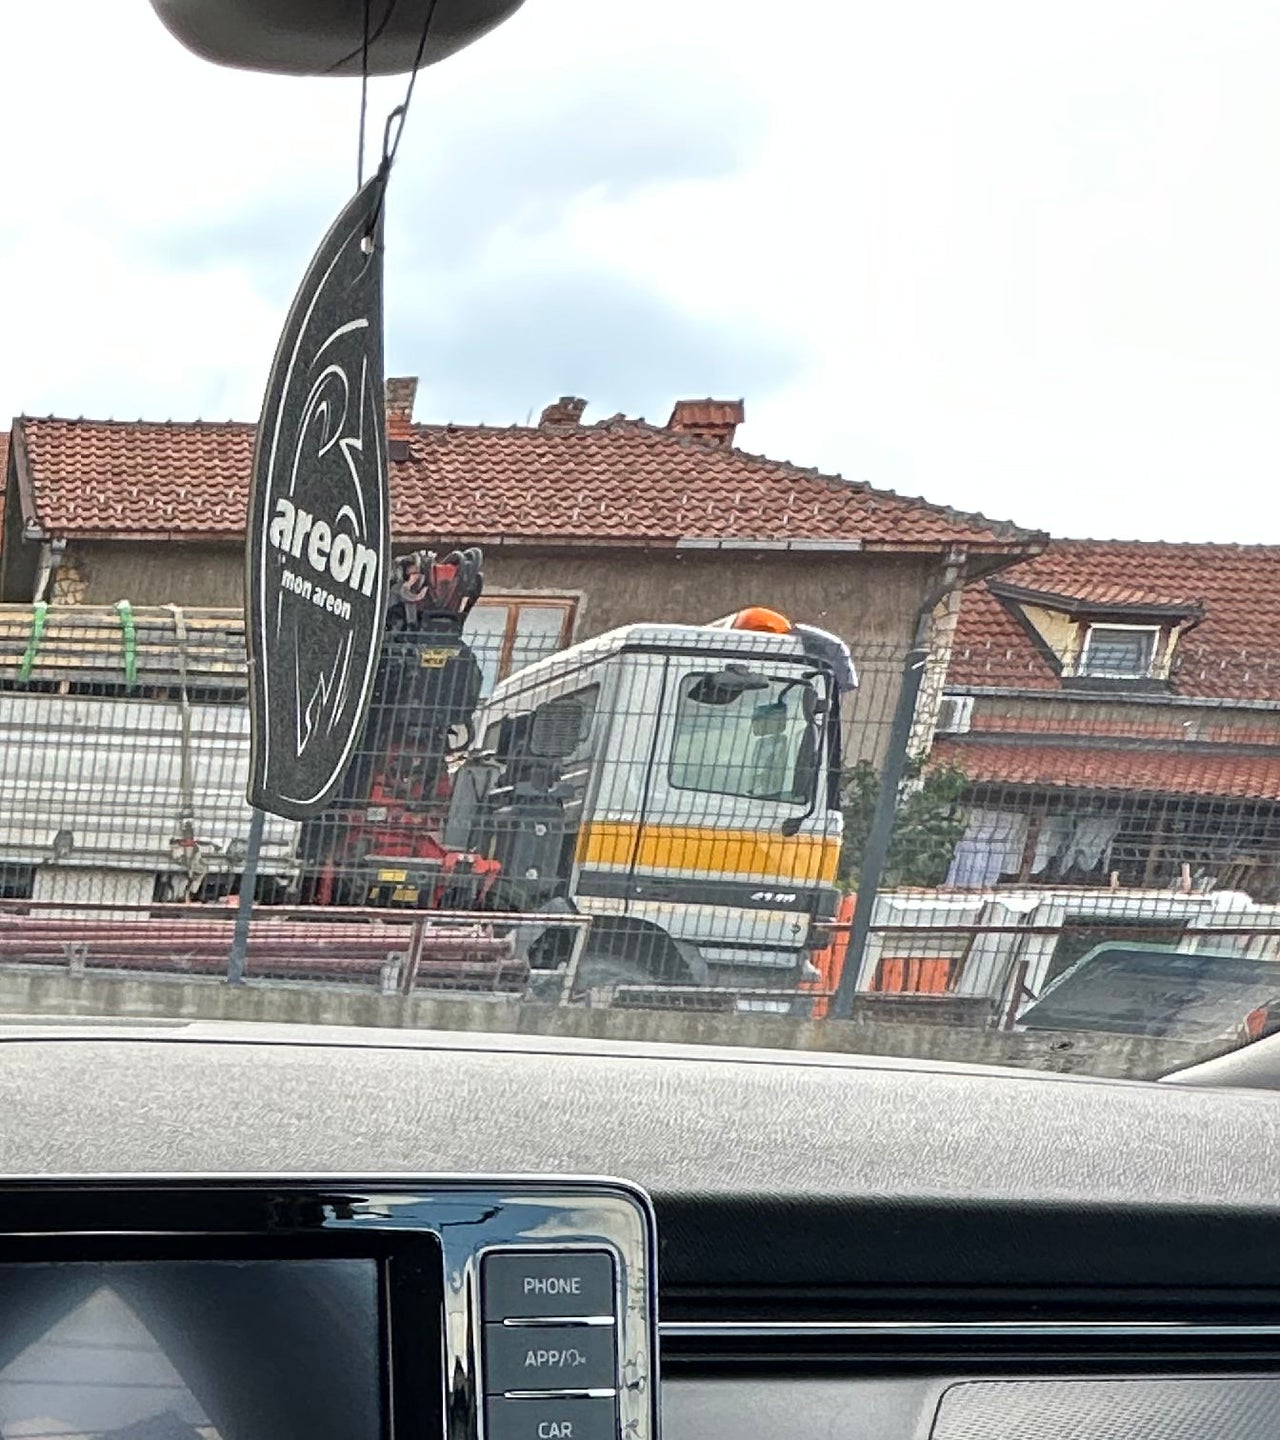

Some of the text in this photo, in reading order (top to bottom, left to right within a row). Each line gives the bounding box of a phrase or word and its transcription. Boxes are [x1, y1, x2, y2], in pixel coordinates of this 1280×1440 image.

[269, 498, 377, 598] areon
[281, 569, 351, 620] mon areon
[523, 1278, 581, 1294] PHONE
[538, 1421, 573, 1438] CAR
